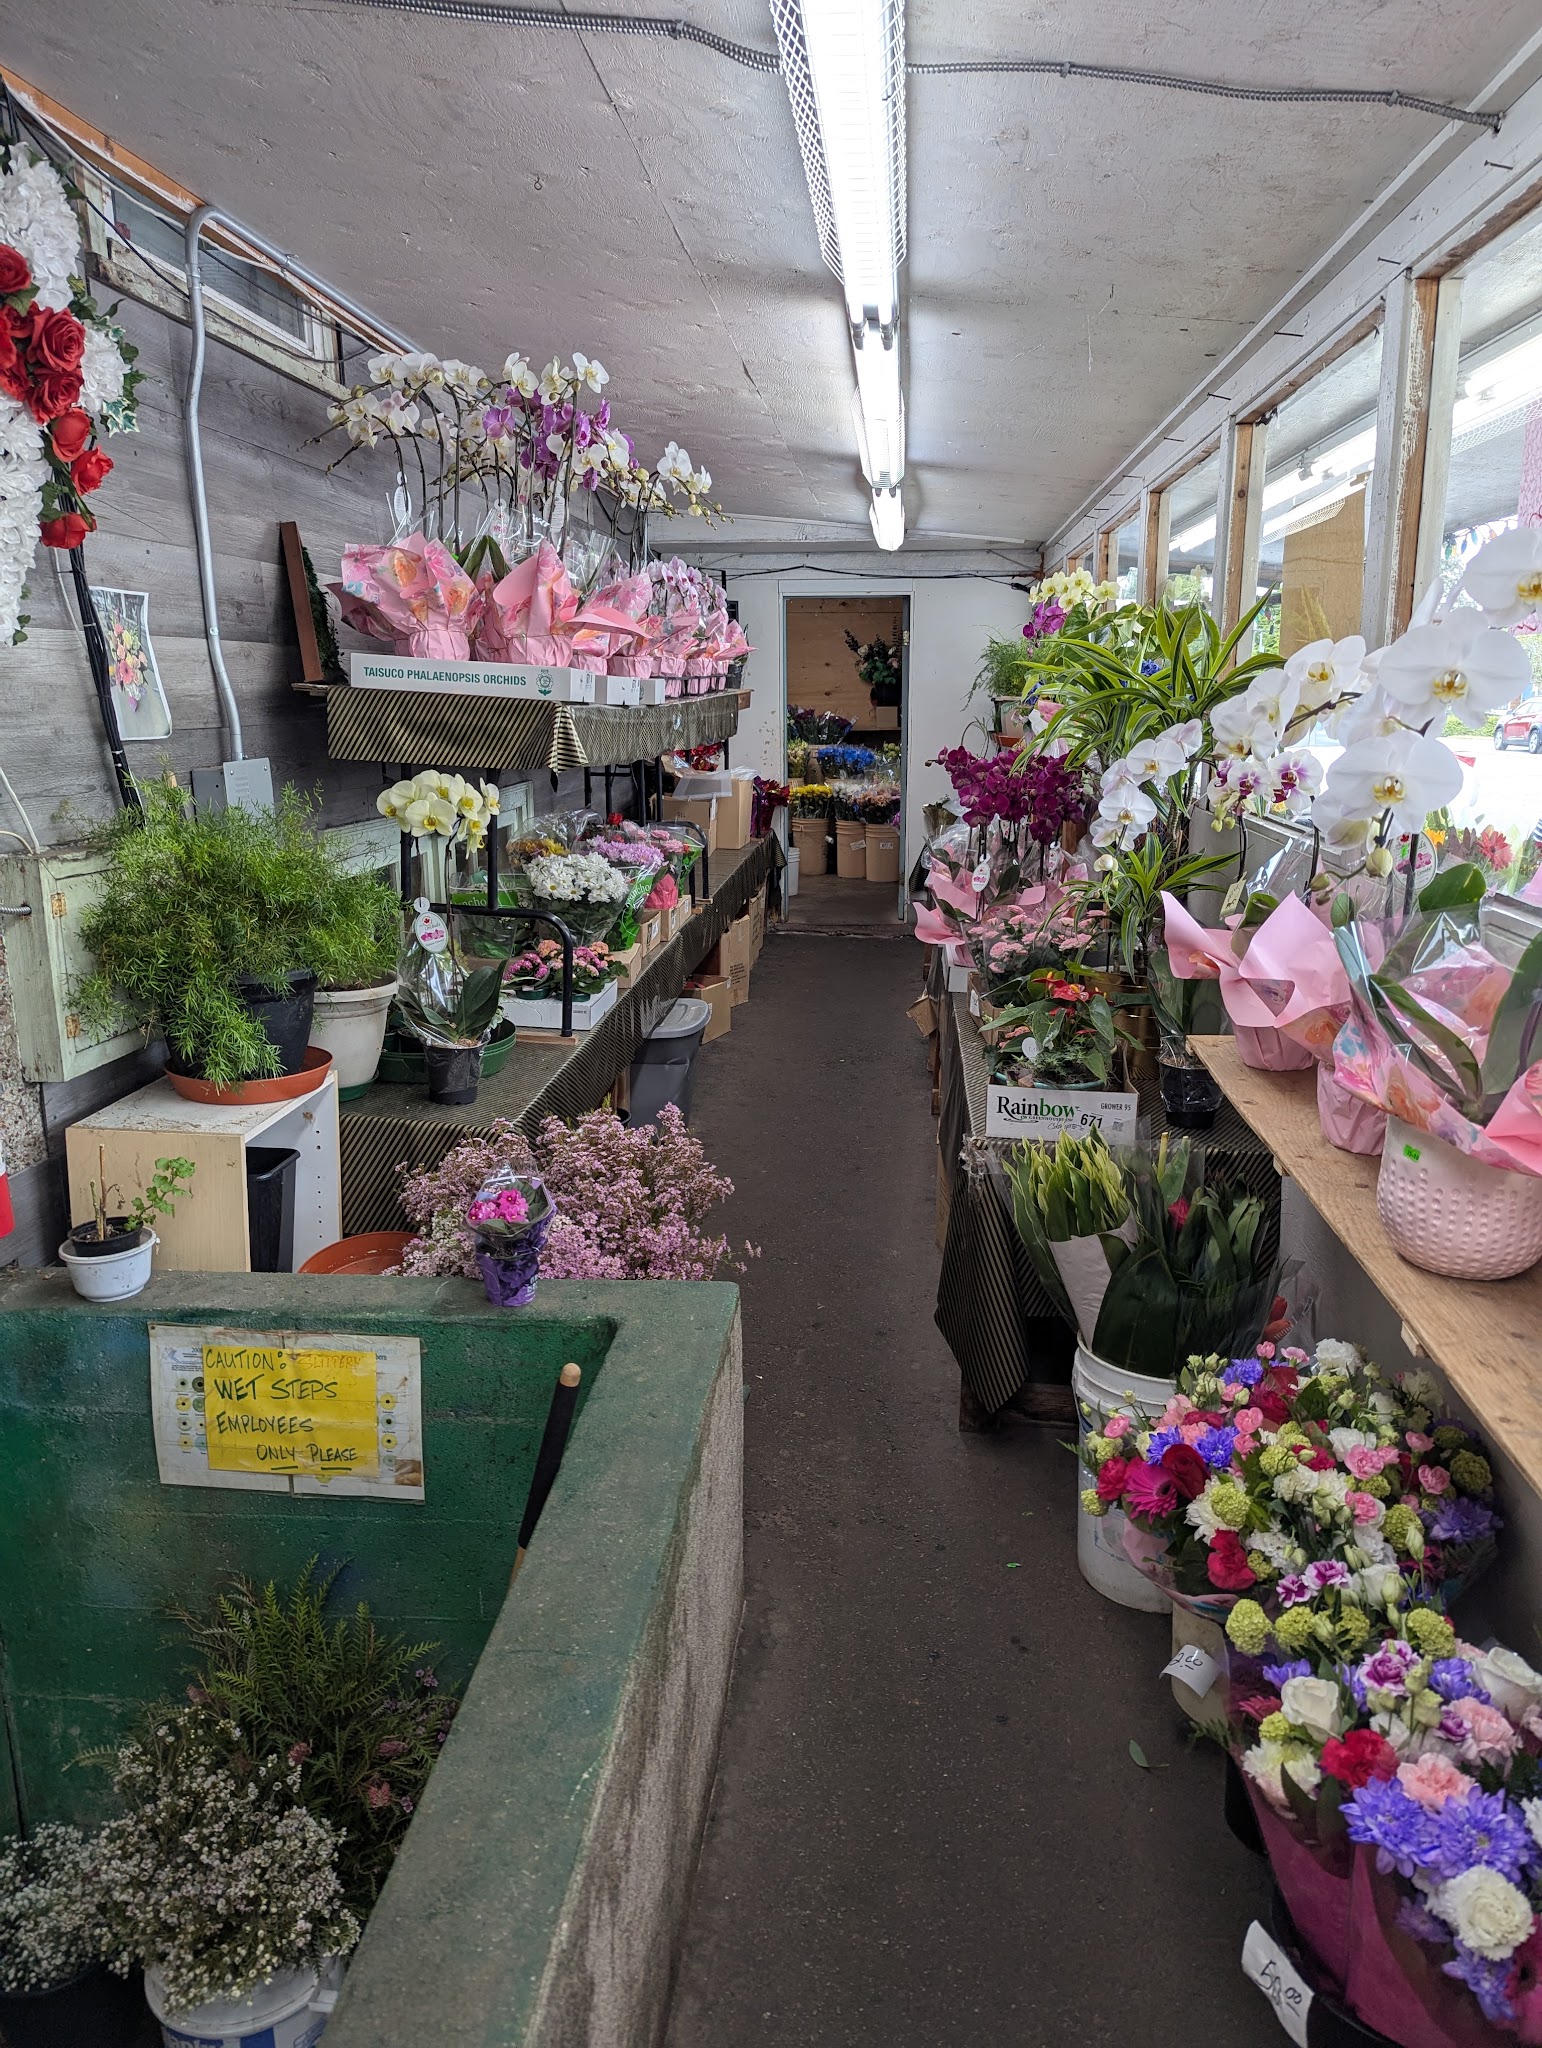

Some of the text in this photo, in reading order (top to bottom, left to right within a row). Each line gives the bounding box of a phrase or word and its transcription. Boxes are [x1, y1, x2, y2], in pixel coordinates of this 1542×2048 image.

[363, 665, 527, 686] TAISUCO PHALAENOPSIS ORCHIDS
[996, 1095, 1077, 1120] Rainbow
[1100, 1102, 1123, 1111] GROWER
[1080, 1113, 1103, 1129] 671
[205, 1349, 288, 1371] CAUTION:
[213, 1373, 339, 1401] WET STEPS
[215, 1410, 315, 1434] EMPLOYEES
[256, 1443, 359, 1463] ONLY PLEASE
